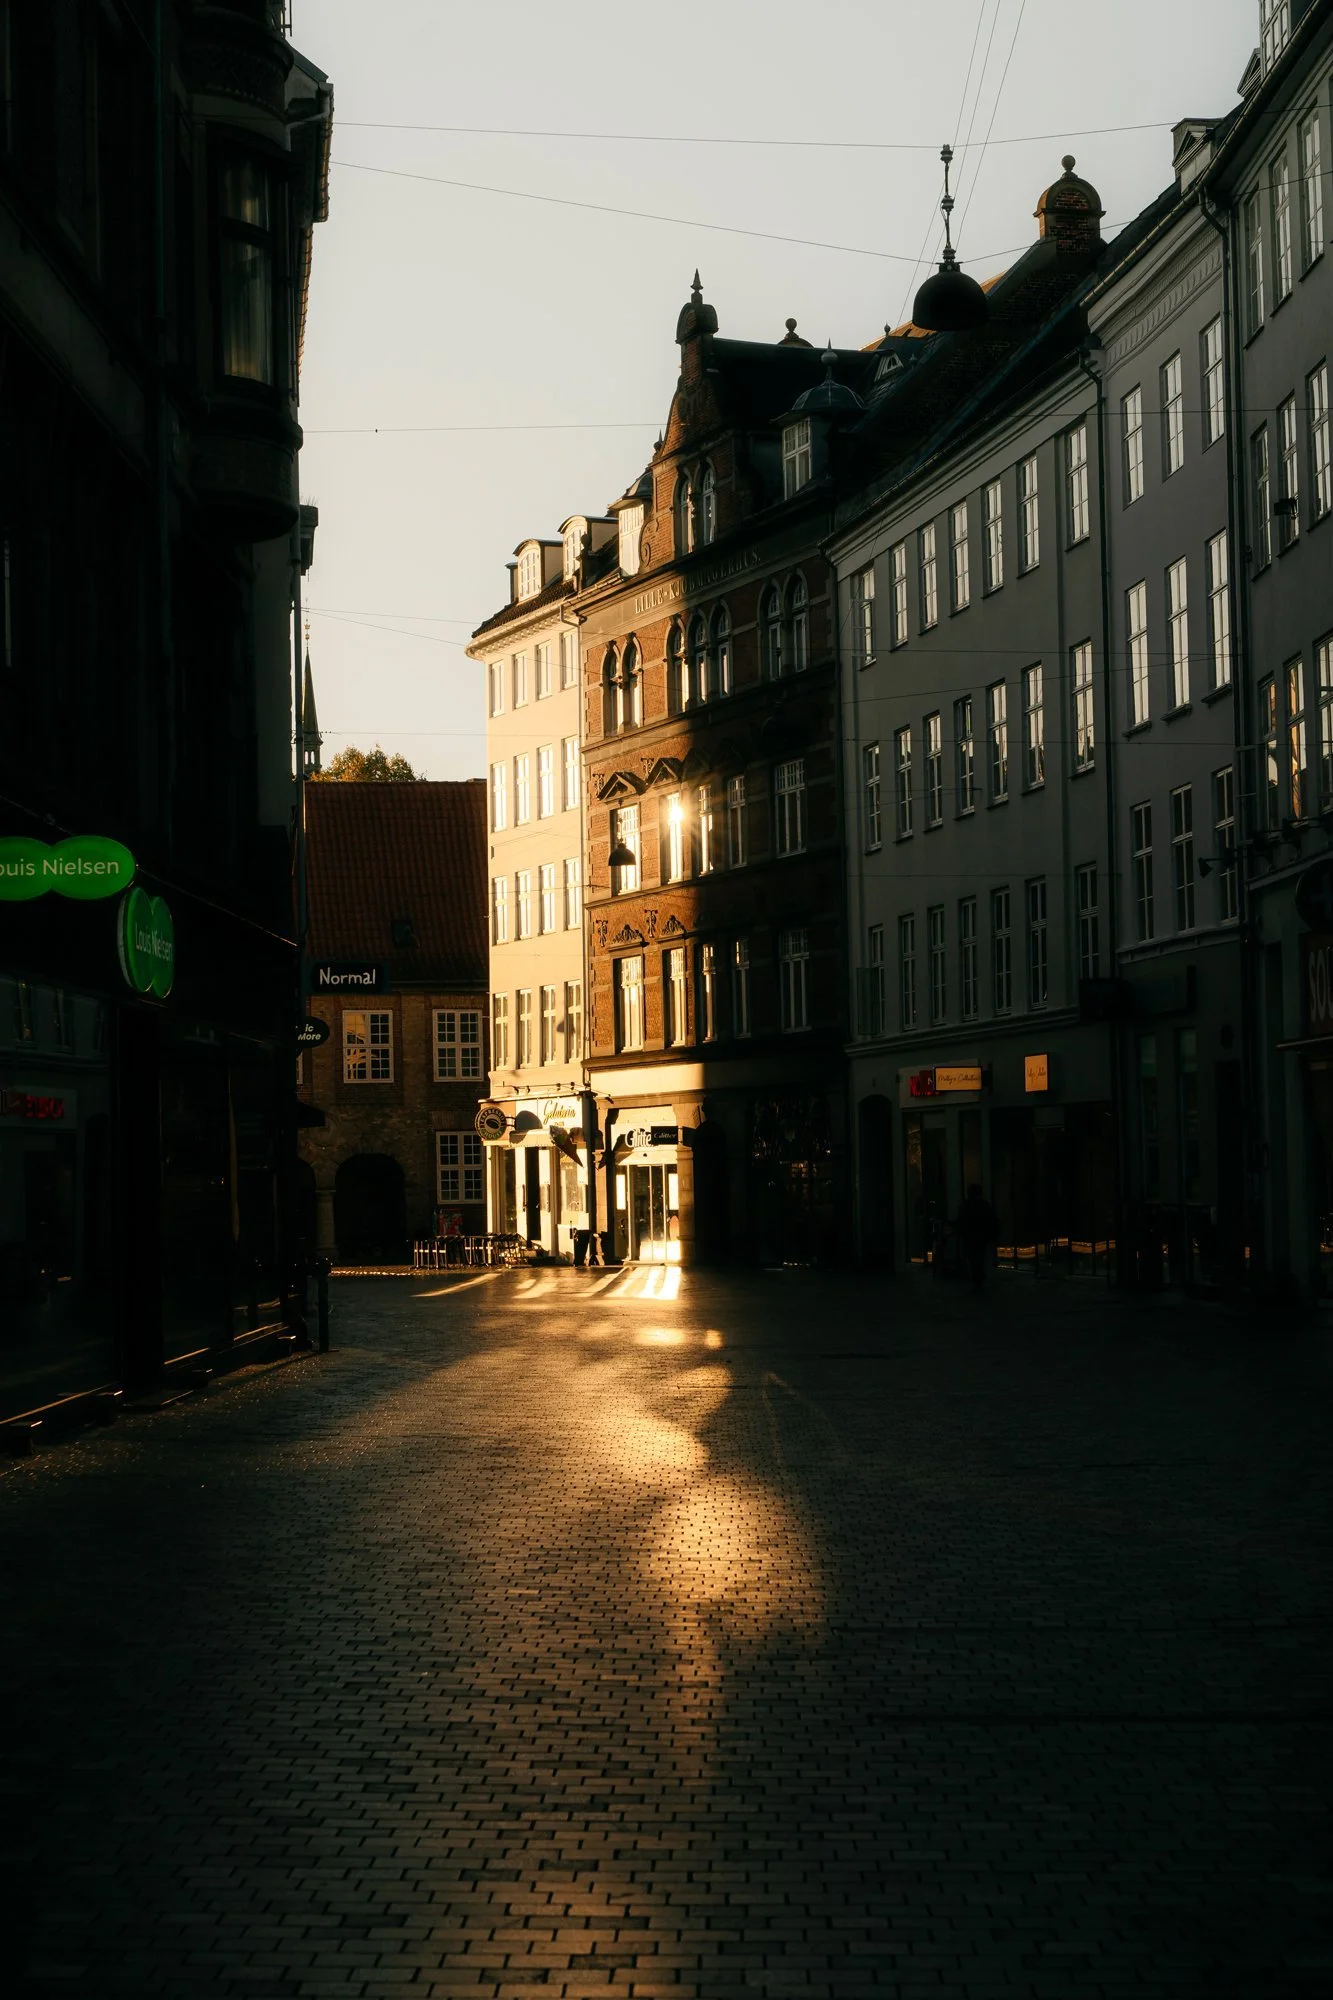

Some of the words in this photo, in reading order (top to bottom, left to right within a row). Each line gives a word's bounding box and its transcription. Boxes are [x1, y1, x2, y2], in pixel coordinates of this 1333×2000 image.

[43, 858, 119, 875] Nielsen
[319, 967, 376, 985] Normal
[480, 1108, 505, 1123] ESPRESSO
[484, 1129, 503, 1139] HOUSE
[625, 1128, 654, 1149] Glitte
